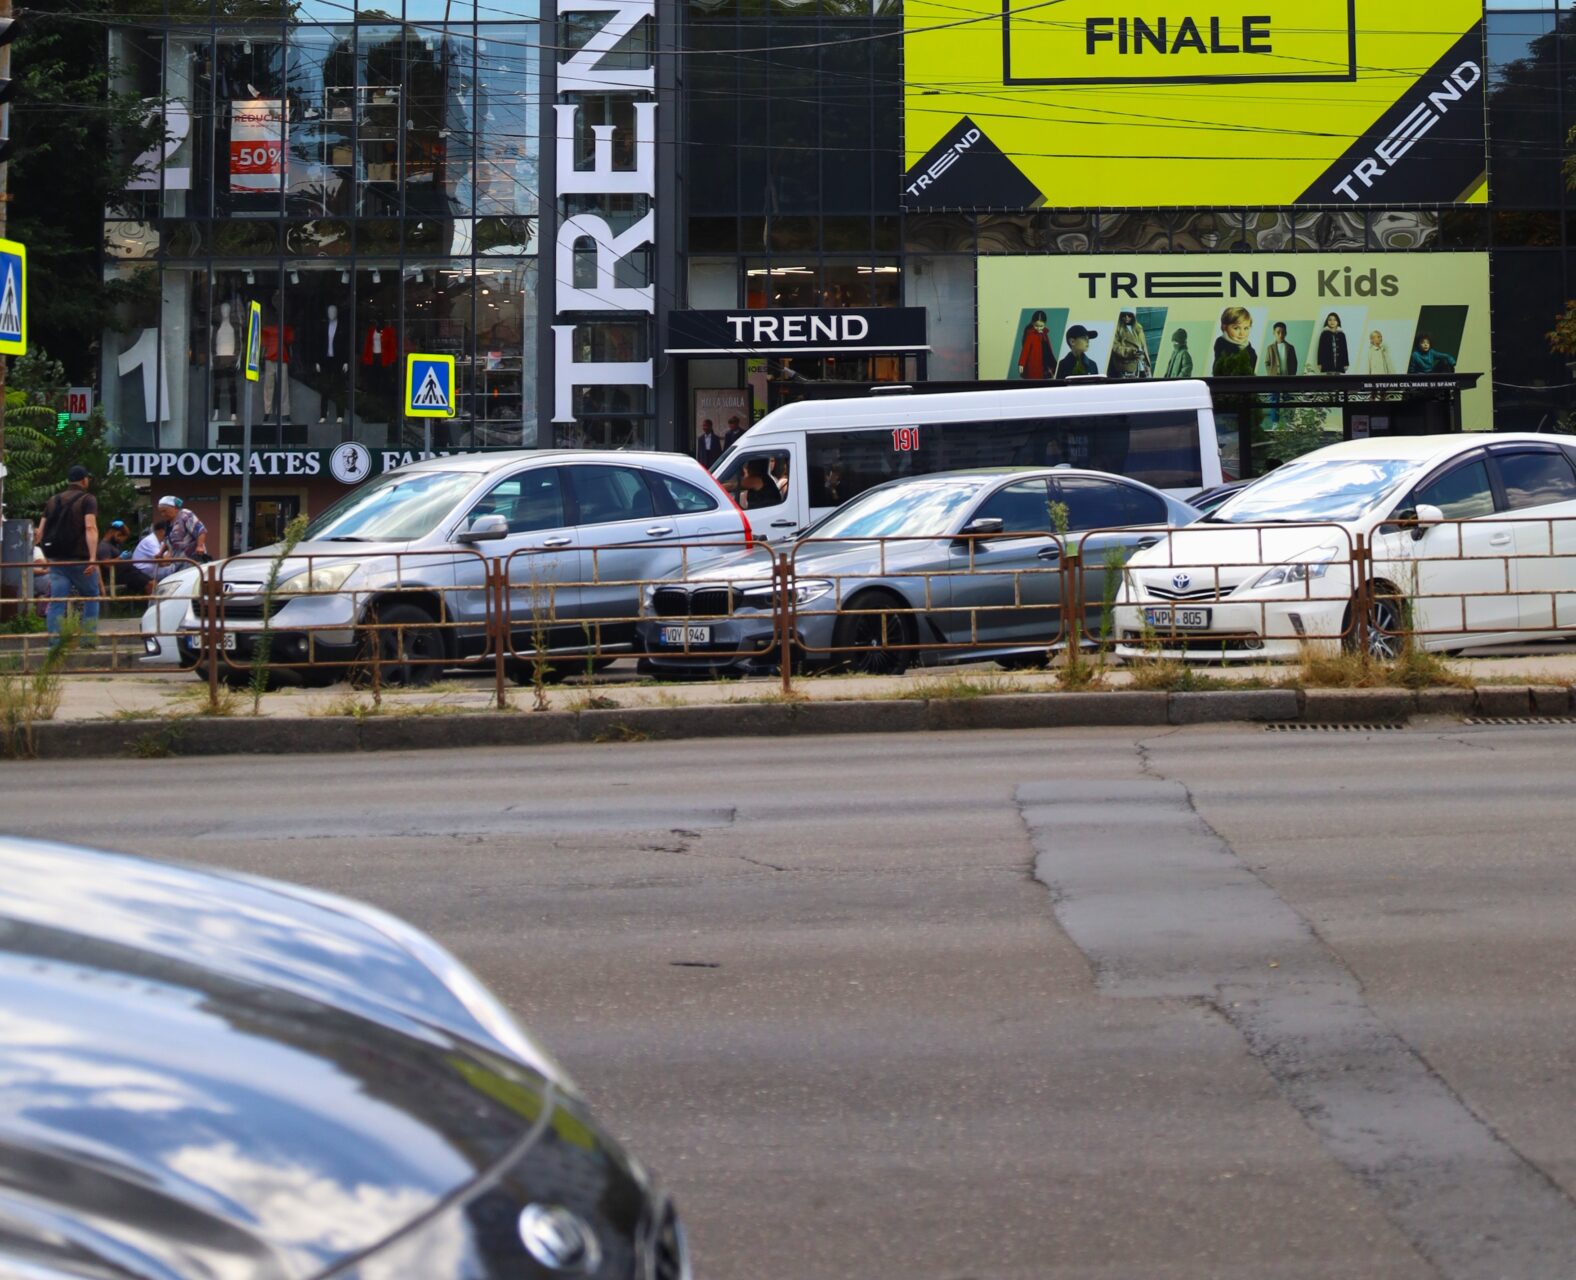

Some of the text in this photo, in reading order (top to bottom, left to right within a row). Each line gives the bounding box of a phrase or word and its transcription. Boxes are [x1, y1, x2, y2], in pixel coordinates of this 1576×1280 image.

[1086, 15, 1273, 56] FINALE
[1332, 60, 1481, 202] TREND
[906, 128, 981, 197] TREND
[1078, 266, 1400, 298] TREND Kids
[726, 315, 869, 342] TREND
[118, 327, 170, 423] 1
[891, 427, 919, 451] 191
[106, 451, 320, 476] HIPPOCRATES
[1182, 611, 1202, 625] 805
[688, 629, 705, 641] 946
